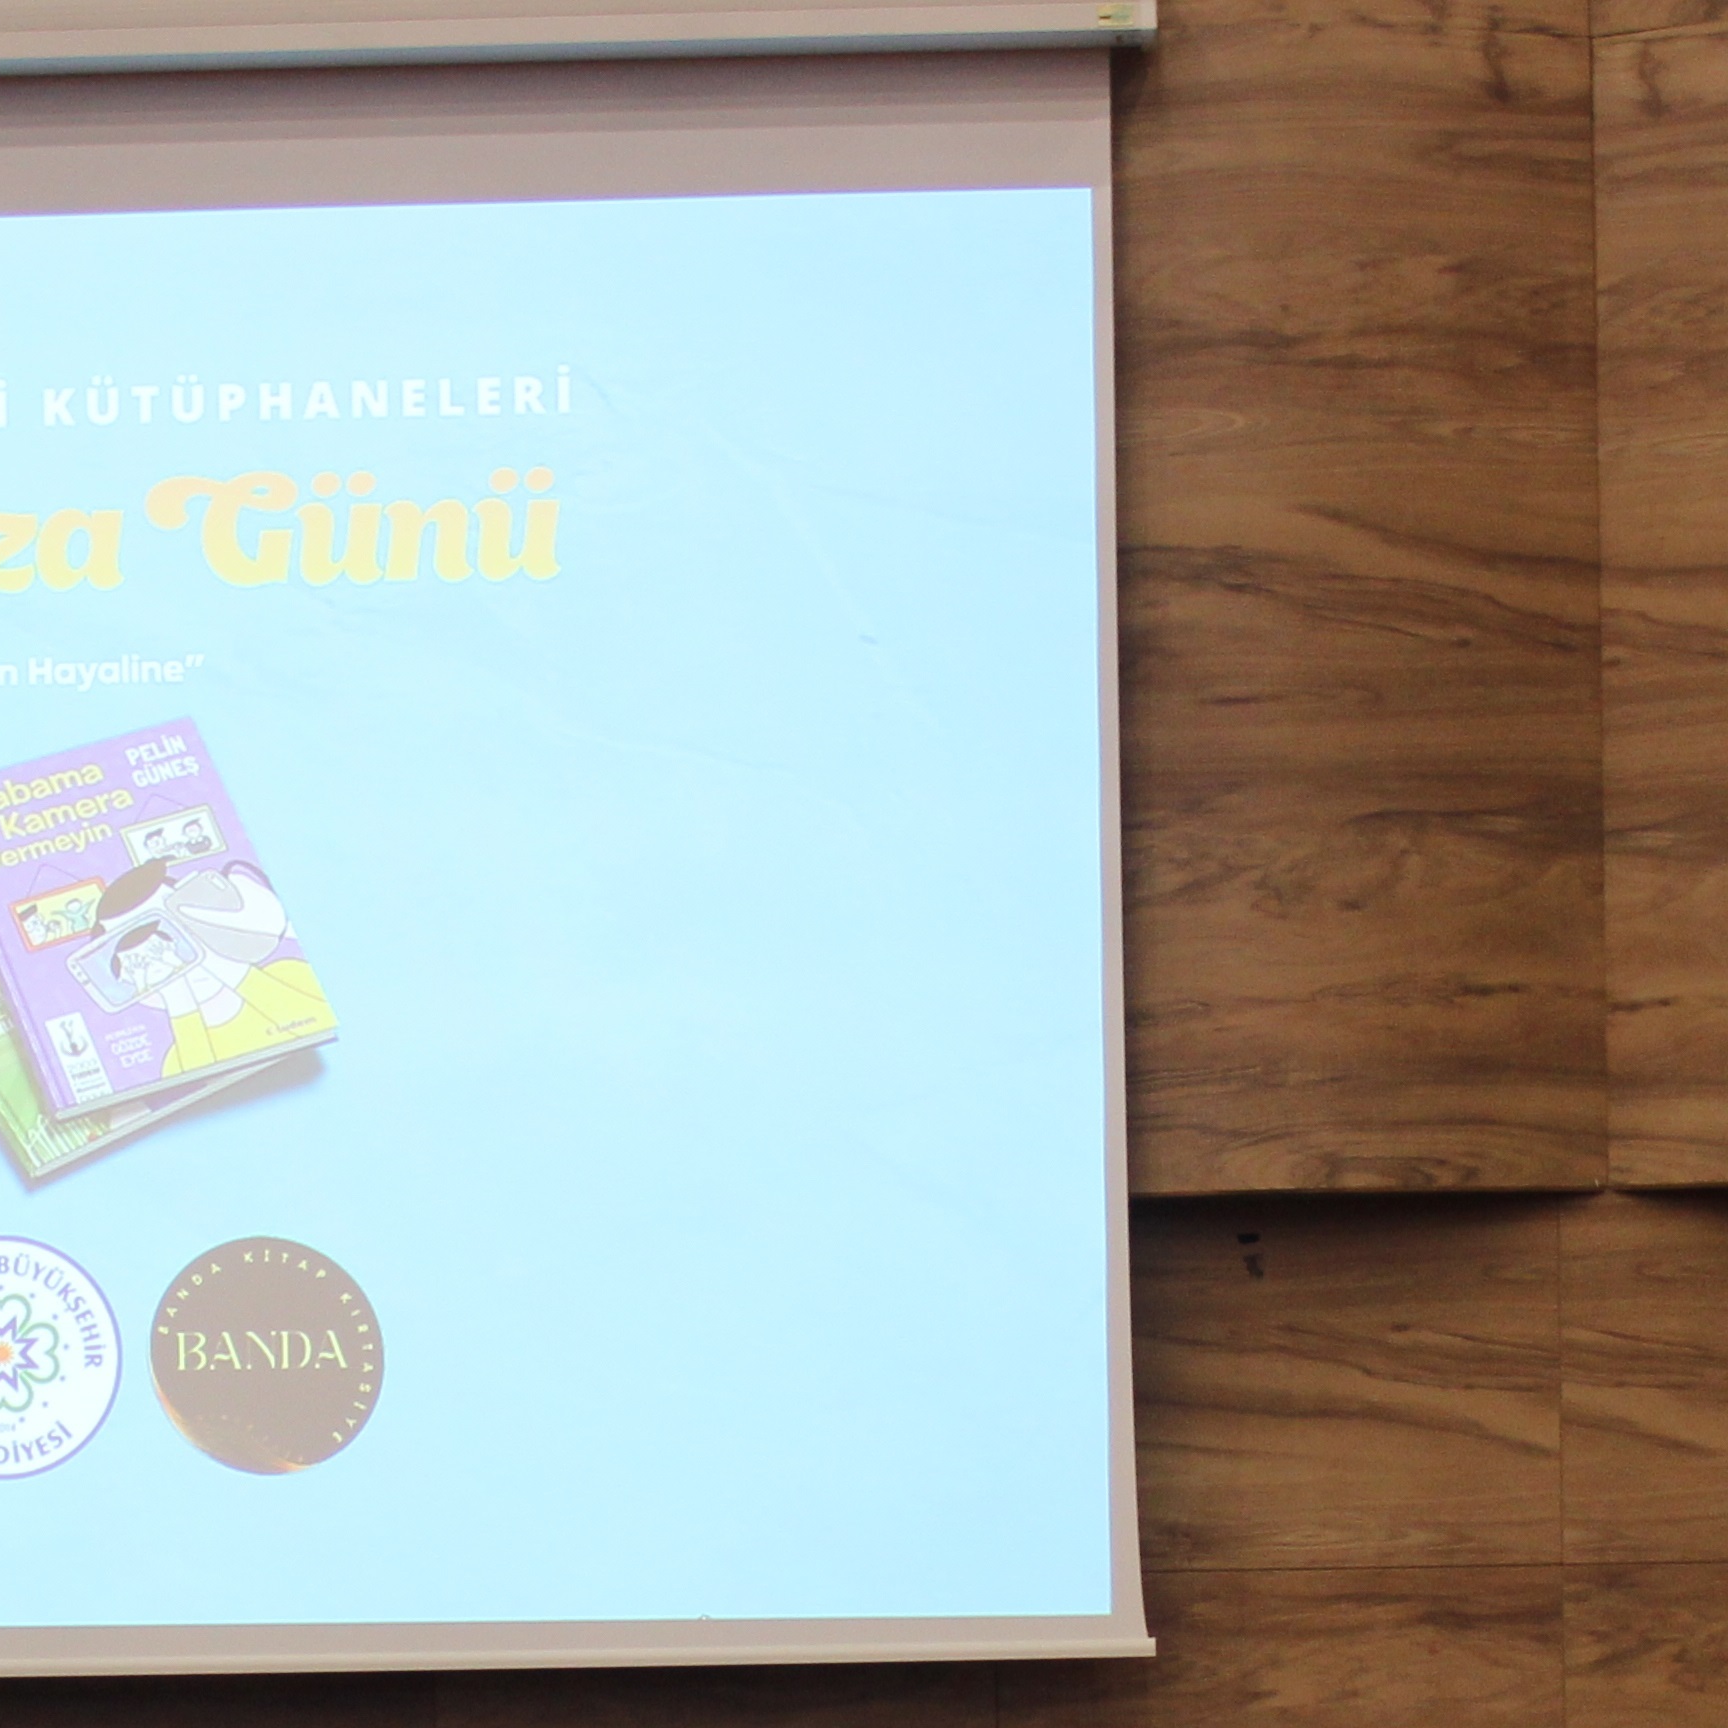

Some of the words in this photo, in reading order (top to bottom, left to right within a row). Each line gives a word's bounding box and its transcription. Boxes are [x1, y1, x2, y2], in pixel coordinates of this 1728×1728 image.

[43, 364, 574, 428] KÜTÜPHANELERİ
[145, 466, 562, 588] Günü
[124, 733, 188, 767] PELİN
[132, 756, 201, 788] GÜNEŞ
[176, 1330, 350, 1371] BANDA
